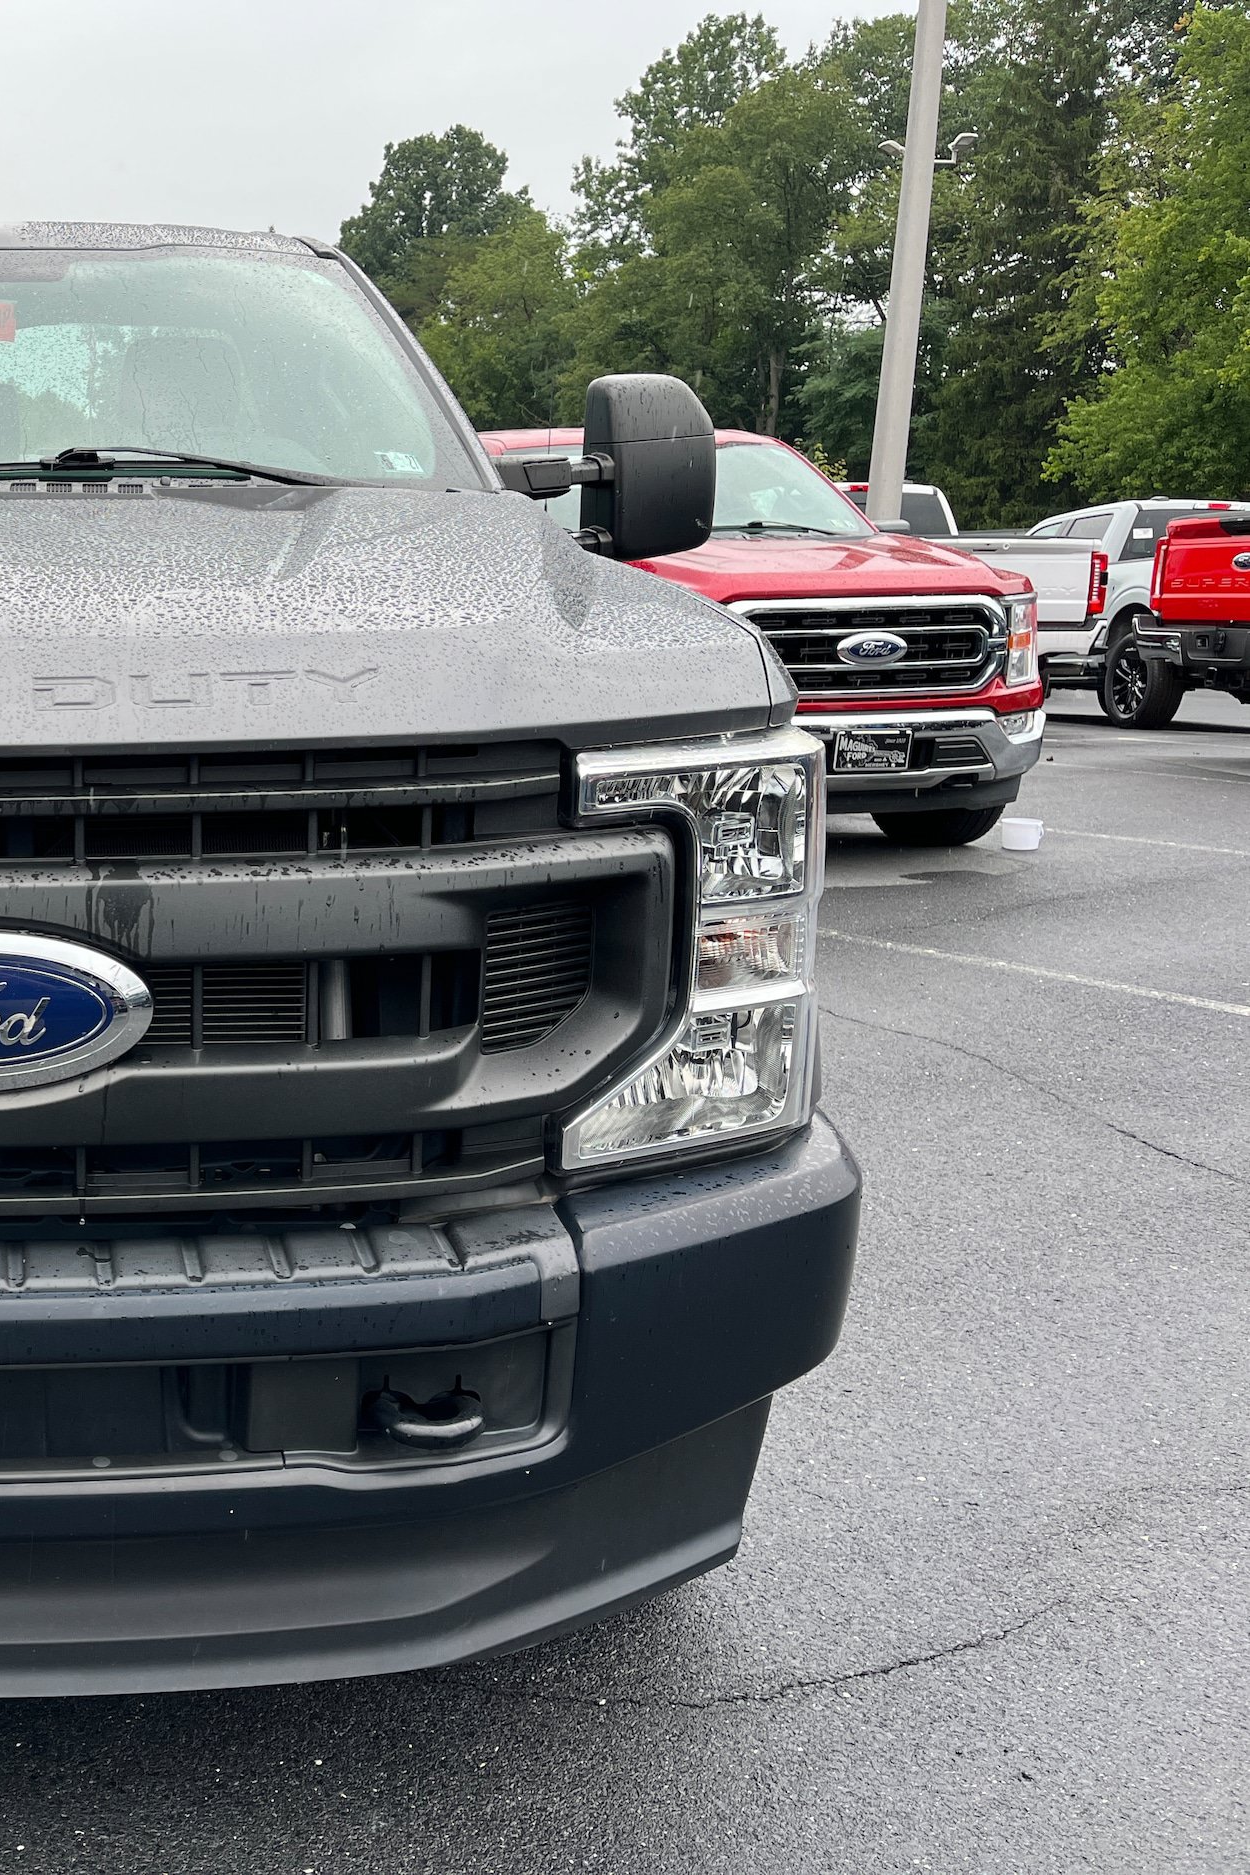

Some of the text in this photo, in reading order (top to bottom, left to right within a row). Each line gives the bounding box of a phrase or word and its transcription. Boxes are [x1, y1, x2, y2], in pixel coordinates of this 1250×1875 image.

[1170, 577, 1250, 588] SUPER
[859, 641, 891, 656] Ford
[32, 667, 381, 711] DUTY
[846, 752, 867, 762] FORD
